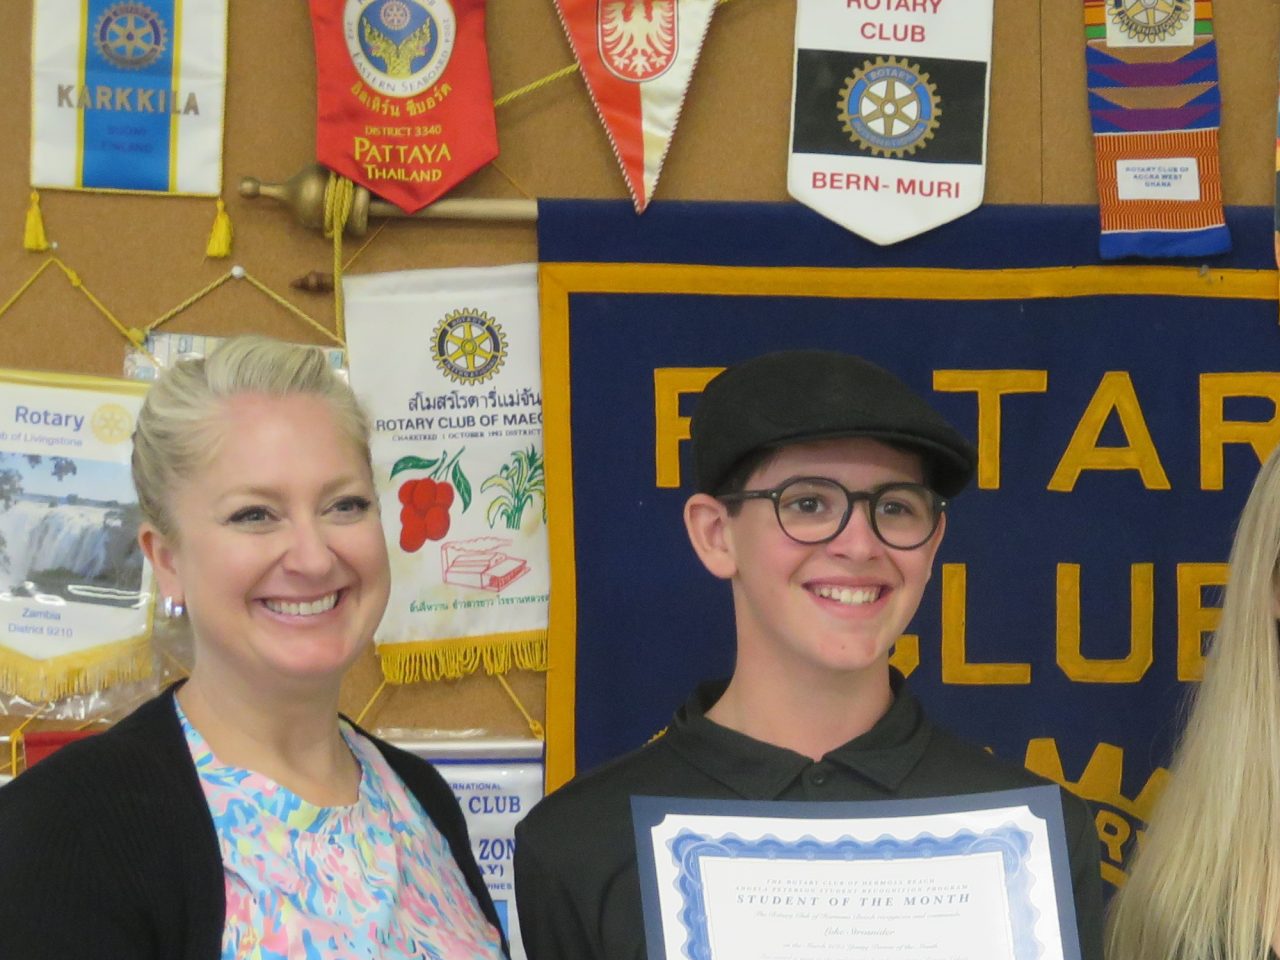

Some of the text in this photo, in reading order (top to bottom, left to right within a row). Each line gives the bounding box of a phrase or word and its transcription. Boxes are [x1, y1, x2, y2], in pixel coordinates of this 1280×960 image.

[860, 22, 926, 43] CLUB
[57, 84, 200, 116] KARKKILA
[365, 124, 442, 137] DISTRICT 3340
[354, 137, 452, 164] PATTAYA
[364, 163, 442, 182] THAILAND
[15, 405, 85, 432] Rotary
[376, 417, 434, 431] ROTARY
[438, 415, 475, 428] CLUB
[480, 414, 498, 426] OF
[24, 432, 83, 447] Livingstone
[22, 607, 61, 621] Zambia
[8, 622, 73, 639] District 9210
[893, 563, 1232, 685] LUB
[468, 796, 521, 814] CLUB
[736, 892, 970, 907] STUDENT OF THE MONTH
